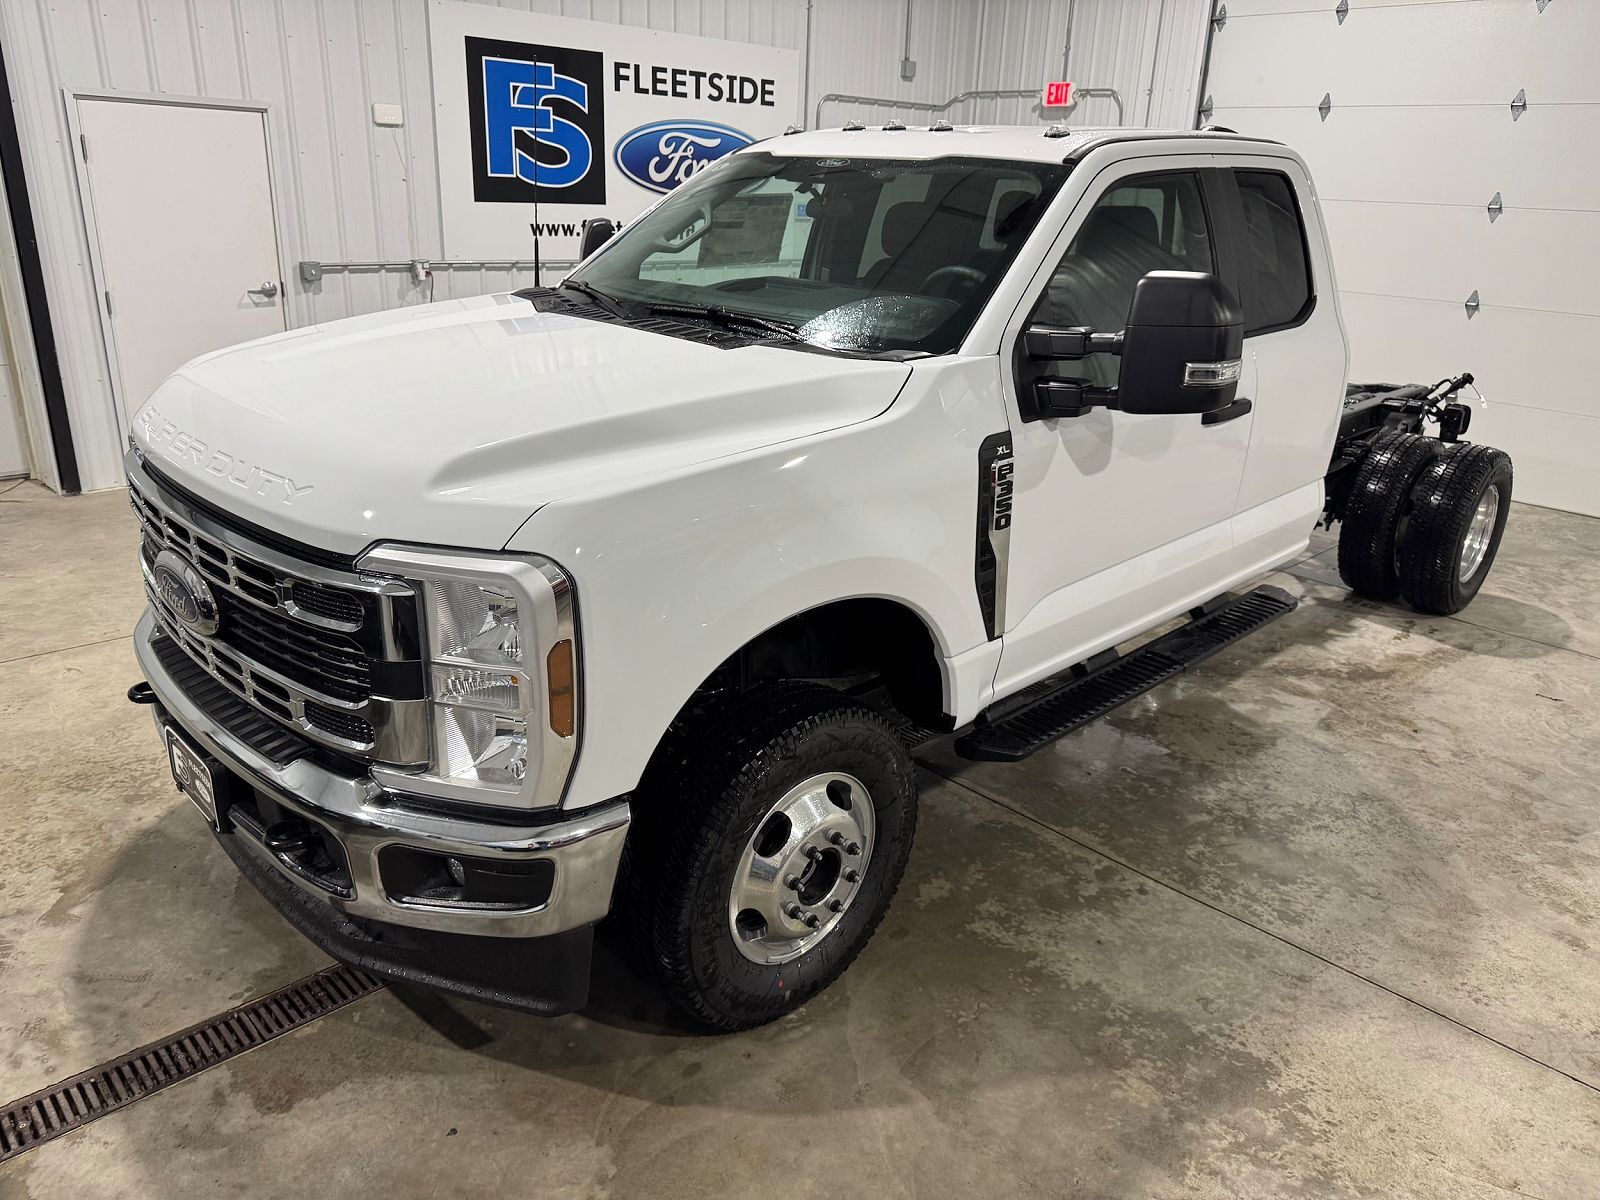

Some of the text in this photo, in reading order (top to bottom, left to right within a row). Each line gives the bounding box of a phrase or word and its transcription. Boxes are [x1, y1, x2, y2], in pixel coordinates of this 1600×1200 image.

[613, 61, 775, 107] FLEETSIDE
[1046, 83, 1071, 105] EXIT
[482, 56, 592, 188] FS
[648, 131, 719, 183] For
[996, 445, 1010, 456] XL
[205, 449, 314, 506] DUTY
[162, 573, 188, 616] Ford
